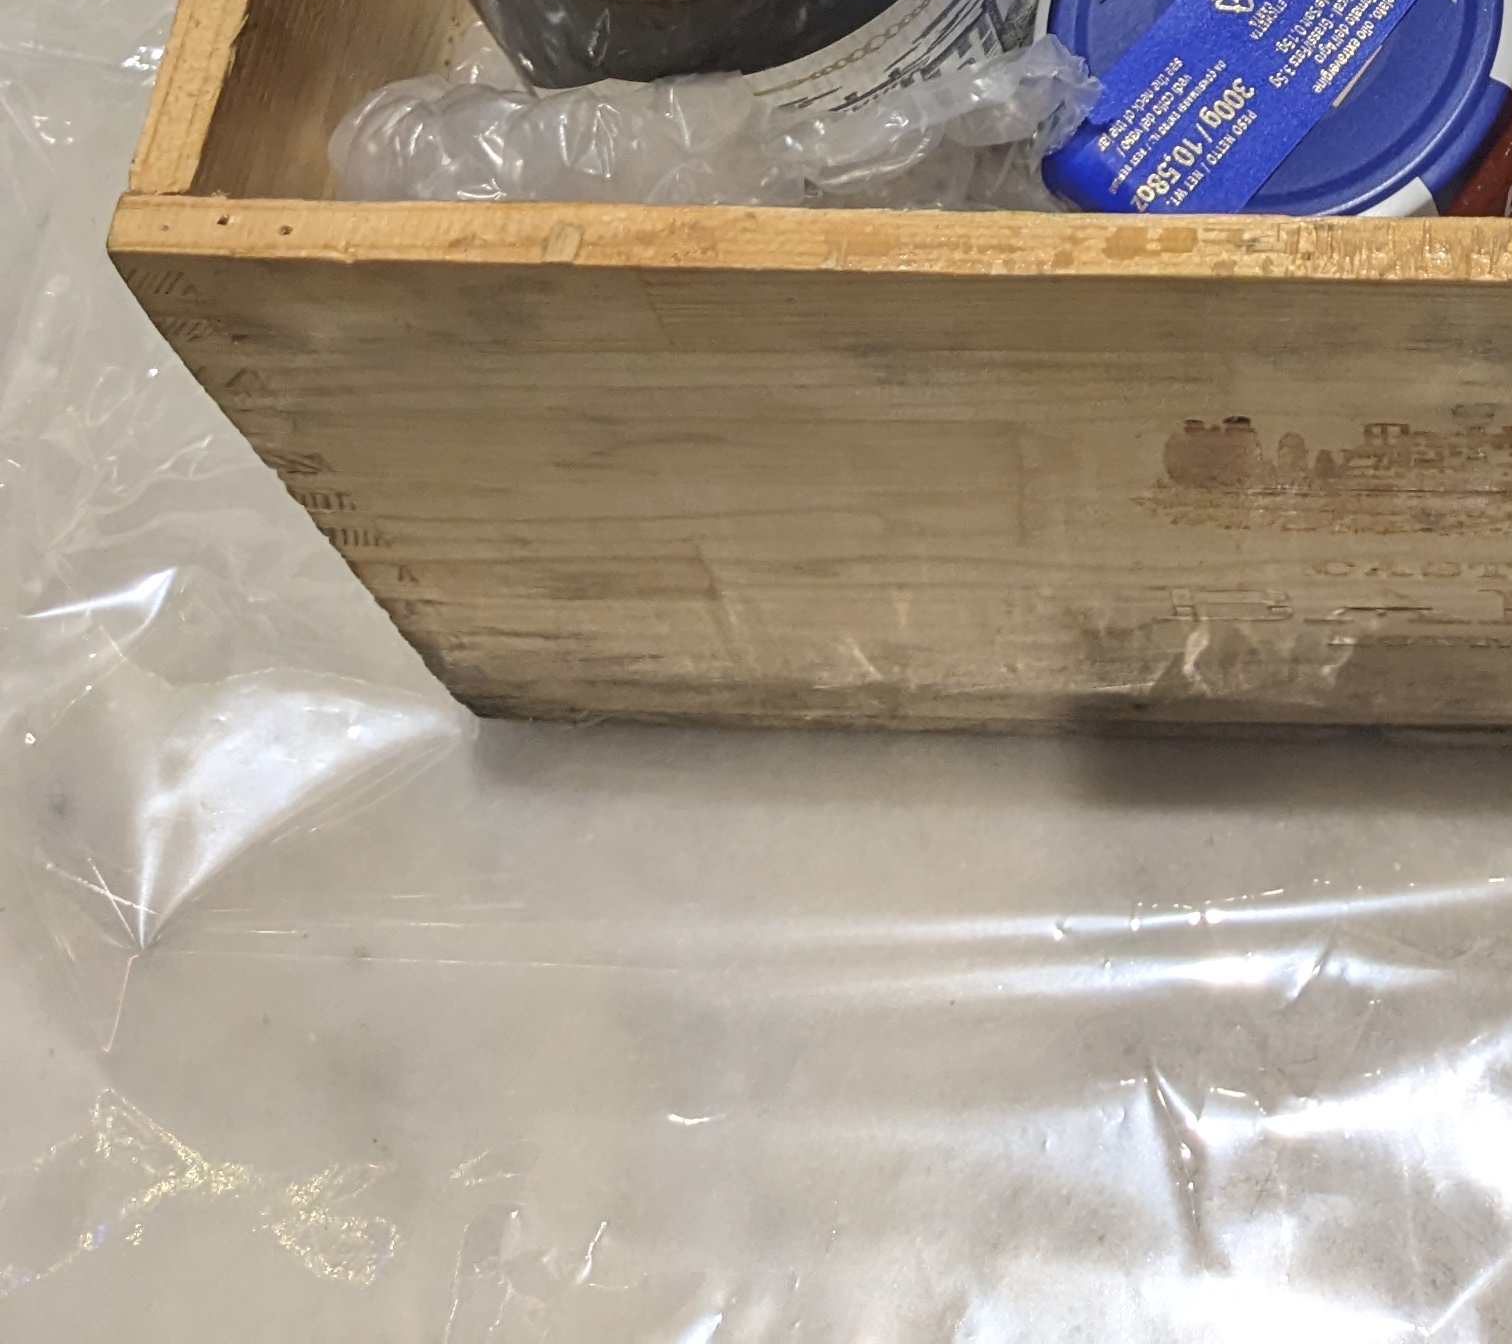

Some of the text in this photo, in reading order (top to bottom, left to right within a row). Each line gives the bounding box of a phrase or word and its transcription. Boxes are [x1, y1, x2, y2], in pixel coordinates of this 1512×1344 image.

[1355, 18, 1376, 42] olio
[1164, 56, 1184, 77] see
[1310, 34, 1361, 96] extravergine
[1169, 71, 1194, 96] vedi
[1130, 86, 1157, 114] neck
[1196, 70, 1257, 134] 300g
[1138, 111, 1158, 131] del
[1118, 125, 1143, 151] vaso
[1124, 128, 1207, 217] 10,58oz
[1164, 107, 1258, 211] PESO NETTO NET WT.
